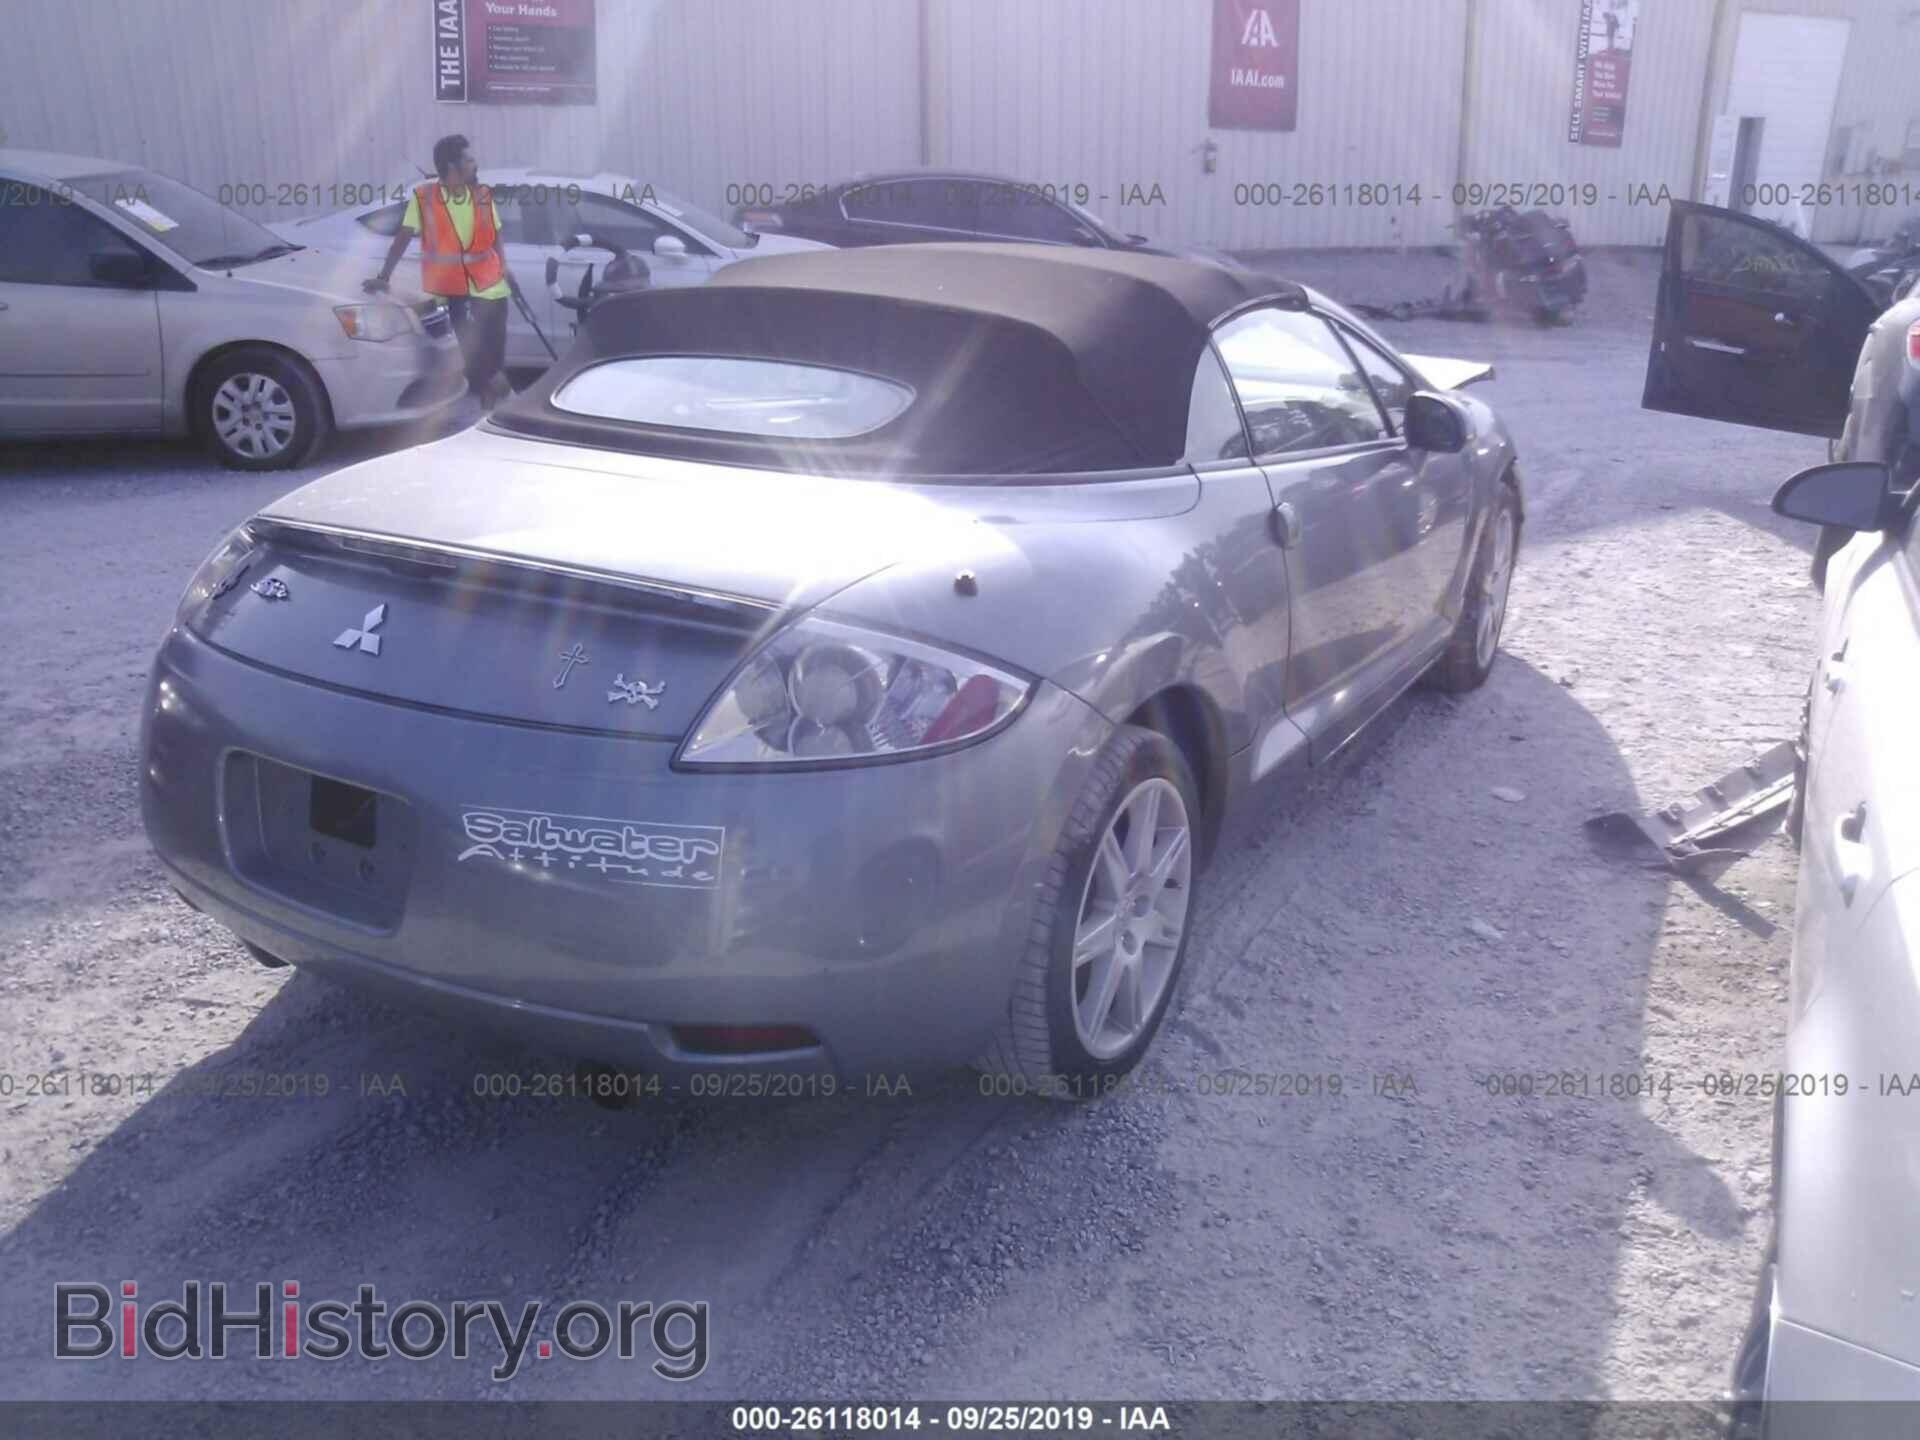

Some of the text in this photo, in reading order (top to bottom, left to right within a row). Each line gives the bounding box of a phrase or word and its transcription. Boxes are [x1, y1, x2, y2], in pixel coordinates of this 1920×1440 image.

[485, 2, 557, 17] Your Hands
[440, 46, 460, 89] THE
[1231, 68, 1285, 89] IAAI.com
[462, 811, 720, 864] Saltwater
